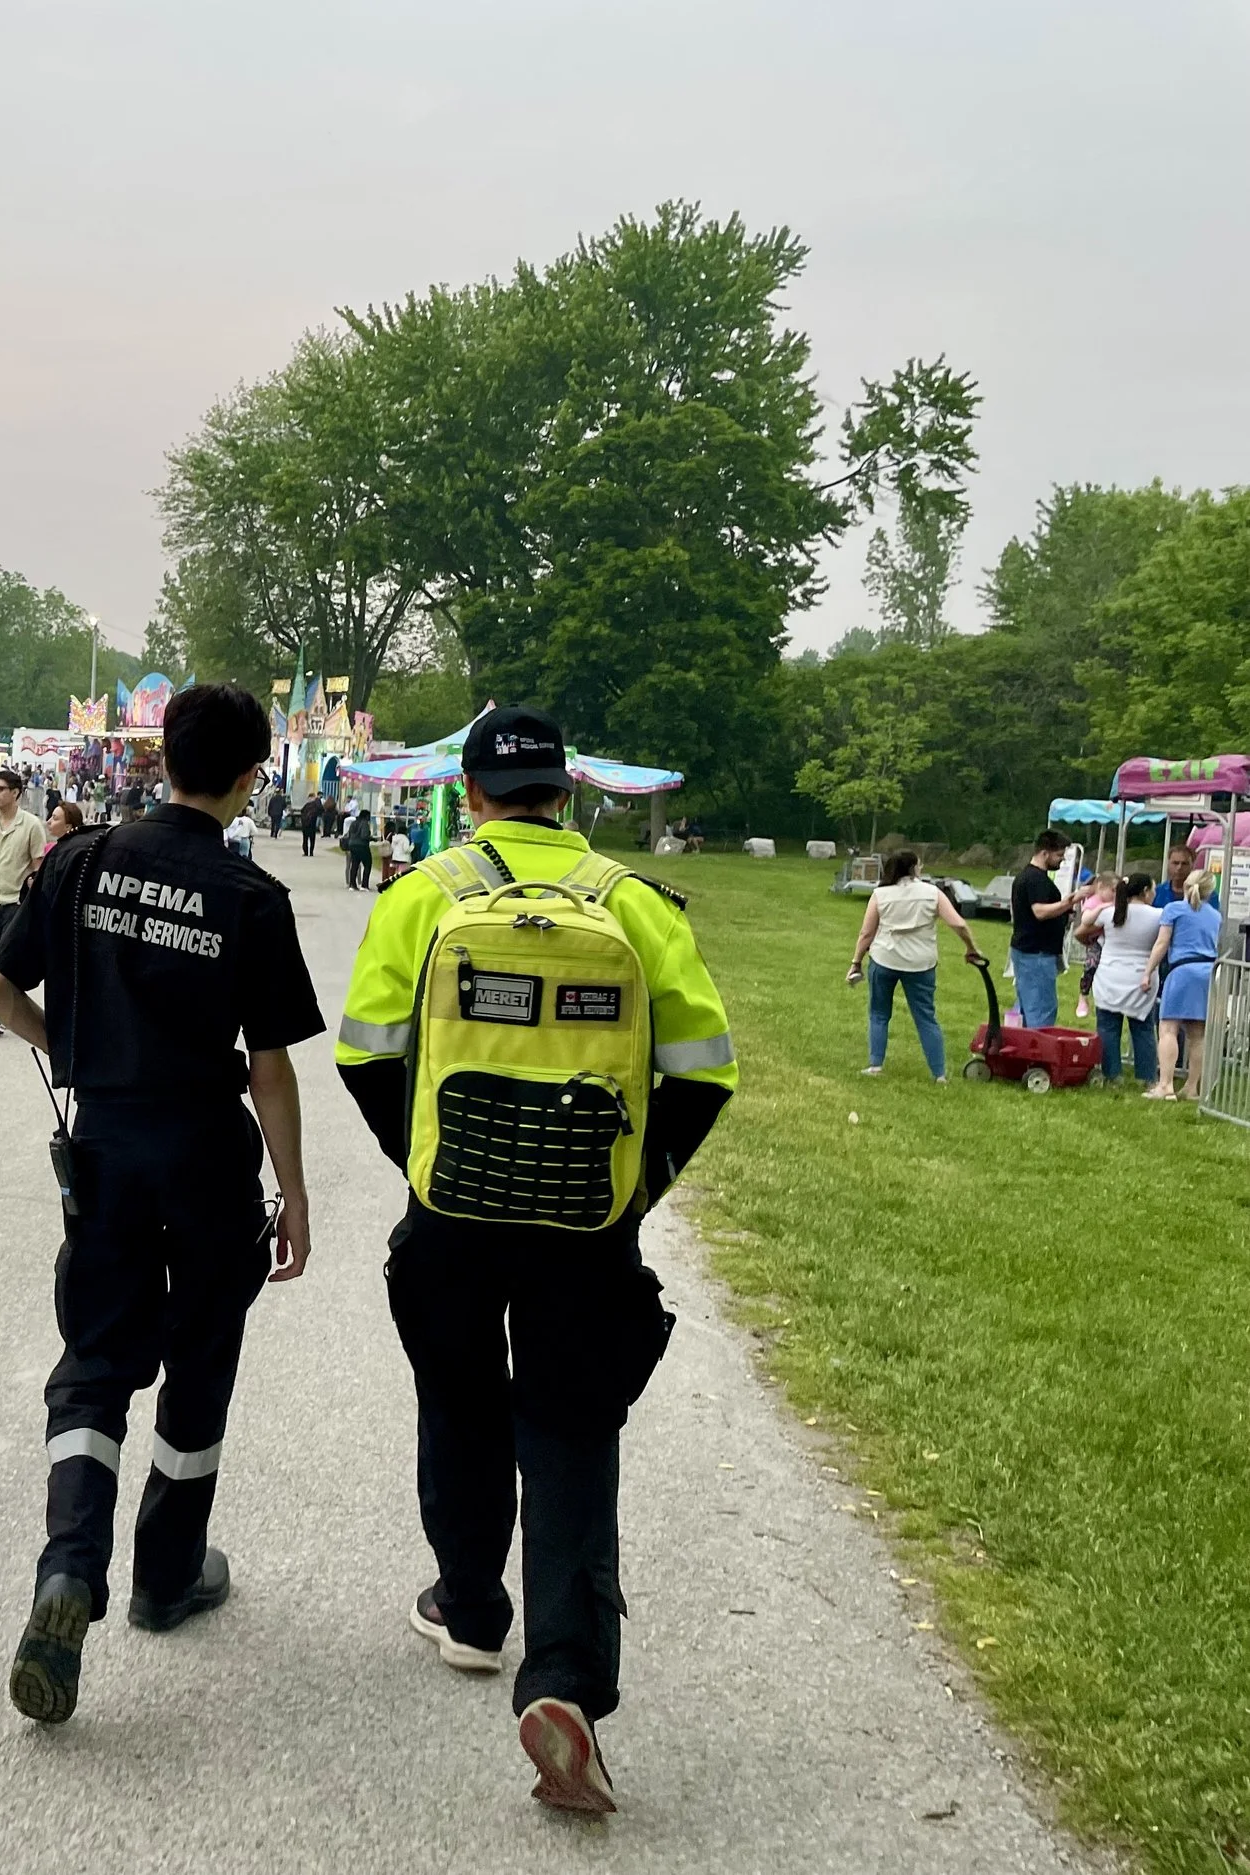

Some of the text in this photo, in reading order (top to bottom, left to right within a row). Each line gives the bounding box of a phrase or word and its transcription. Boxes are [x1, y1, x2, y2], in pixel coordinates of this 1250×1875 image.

[1150, 758, 1220, 781] EXIT
[97, 871, 204, 917] NPEMA
[142, 917, 222, 959] SERVICES
[475, 989, 529, 1006] MERET
